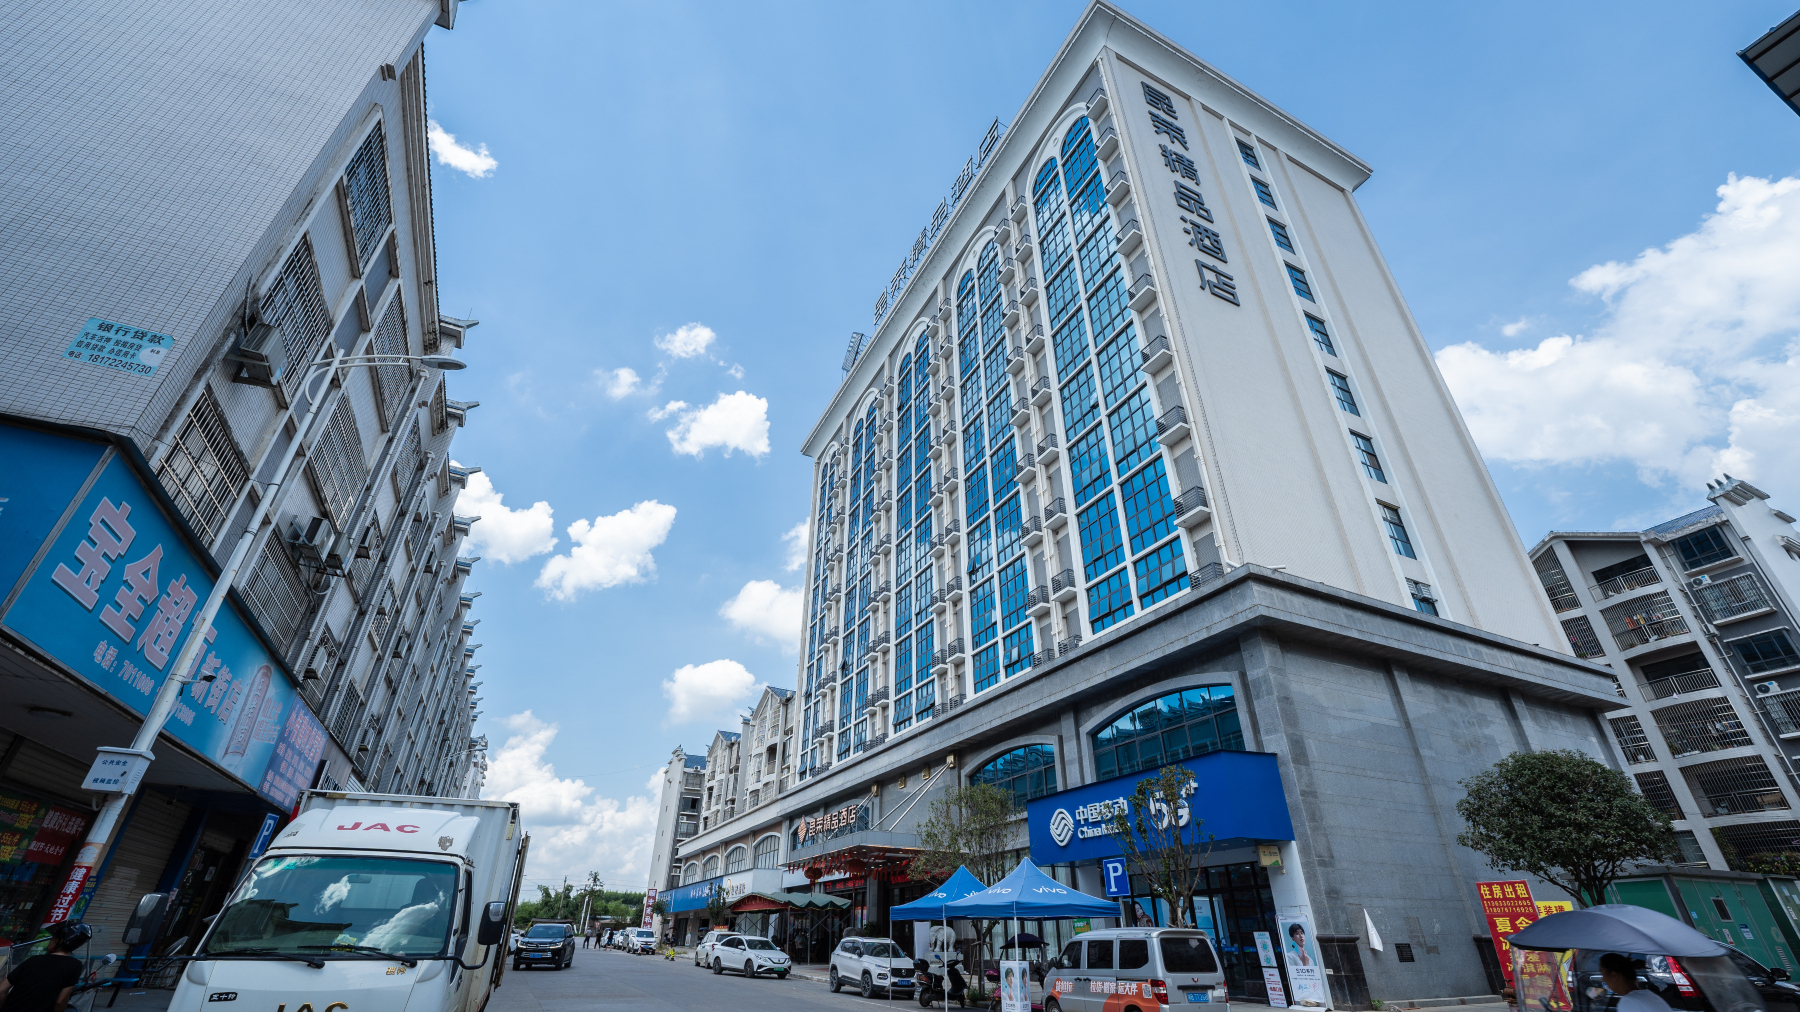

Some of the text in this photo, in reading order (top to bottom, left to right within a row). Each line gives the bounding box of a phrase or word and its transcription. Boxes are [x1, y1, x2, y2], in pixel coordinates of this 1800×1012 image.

[1141, 80, 1240, 306] 昆荣精品酒店
[874, 116, 999, 325] 昆荣精品酒店
[97, 322, 165, 345] 银行贷款
[75, 340, 106, 353] 信用贷款
[87, 353, 152, 375] 18172245730
[101, 759, 128, 767] 公共安全
[92, 777, 120, 785] 视频监控
[1075, 796, 1129, 824] 中国移动
[336, 821, 421, 834] JAC
[808, 804, 857, 837] 昆荣精品酒店
[253, 819, 275, 854] P
[1077, 825, 1102, 839] China
[1106, 862, 1123, 893] P
[50, 867, 87, 922] 健康过节
[927, 891, 947, 899] vivo
[988, 886, 1012, 895] vivo
[1032, 885, 1067, 895] vivo
[1480, 883, 1529, 899] 住房出租
